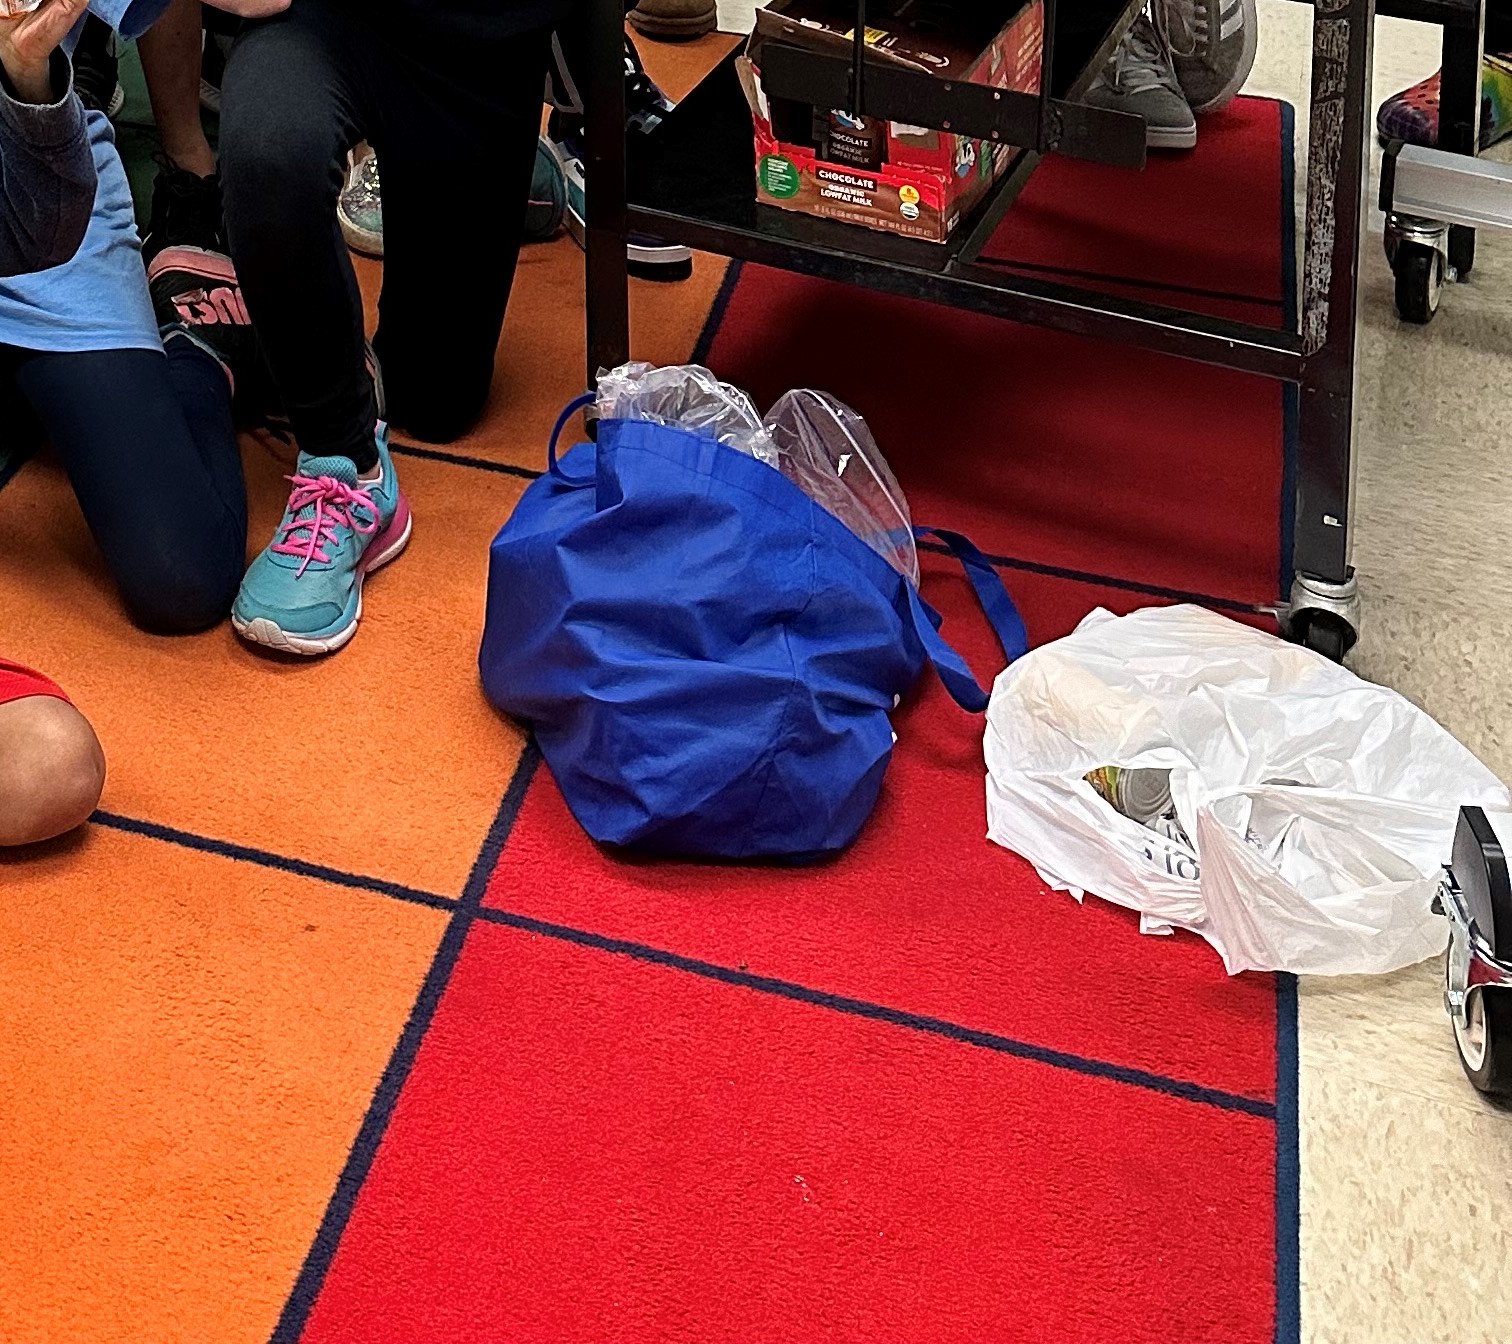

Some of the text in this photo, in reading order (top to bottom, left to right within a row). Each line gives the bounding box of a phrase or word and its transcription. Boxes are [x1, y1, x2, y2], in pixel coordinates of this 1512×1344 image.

[818, 169, 875, 190] CHOCOLATE
[820, 188, 873, 207] LOWFAT MILK
[827, 184, 866, 197] ORGANIC
